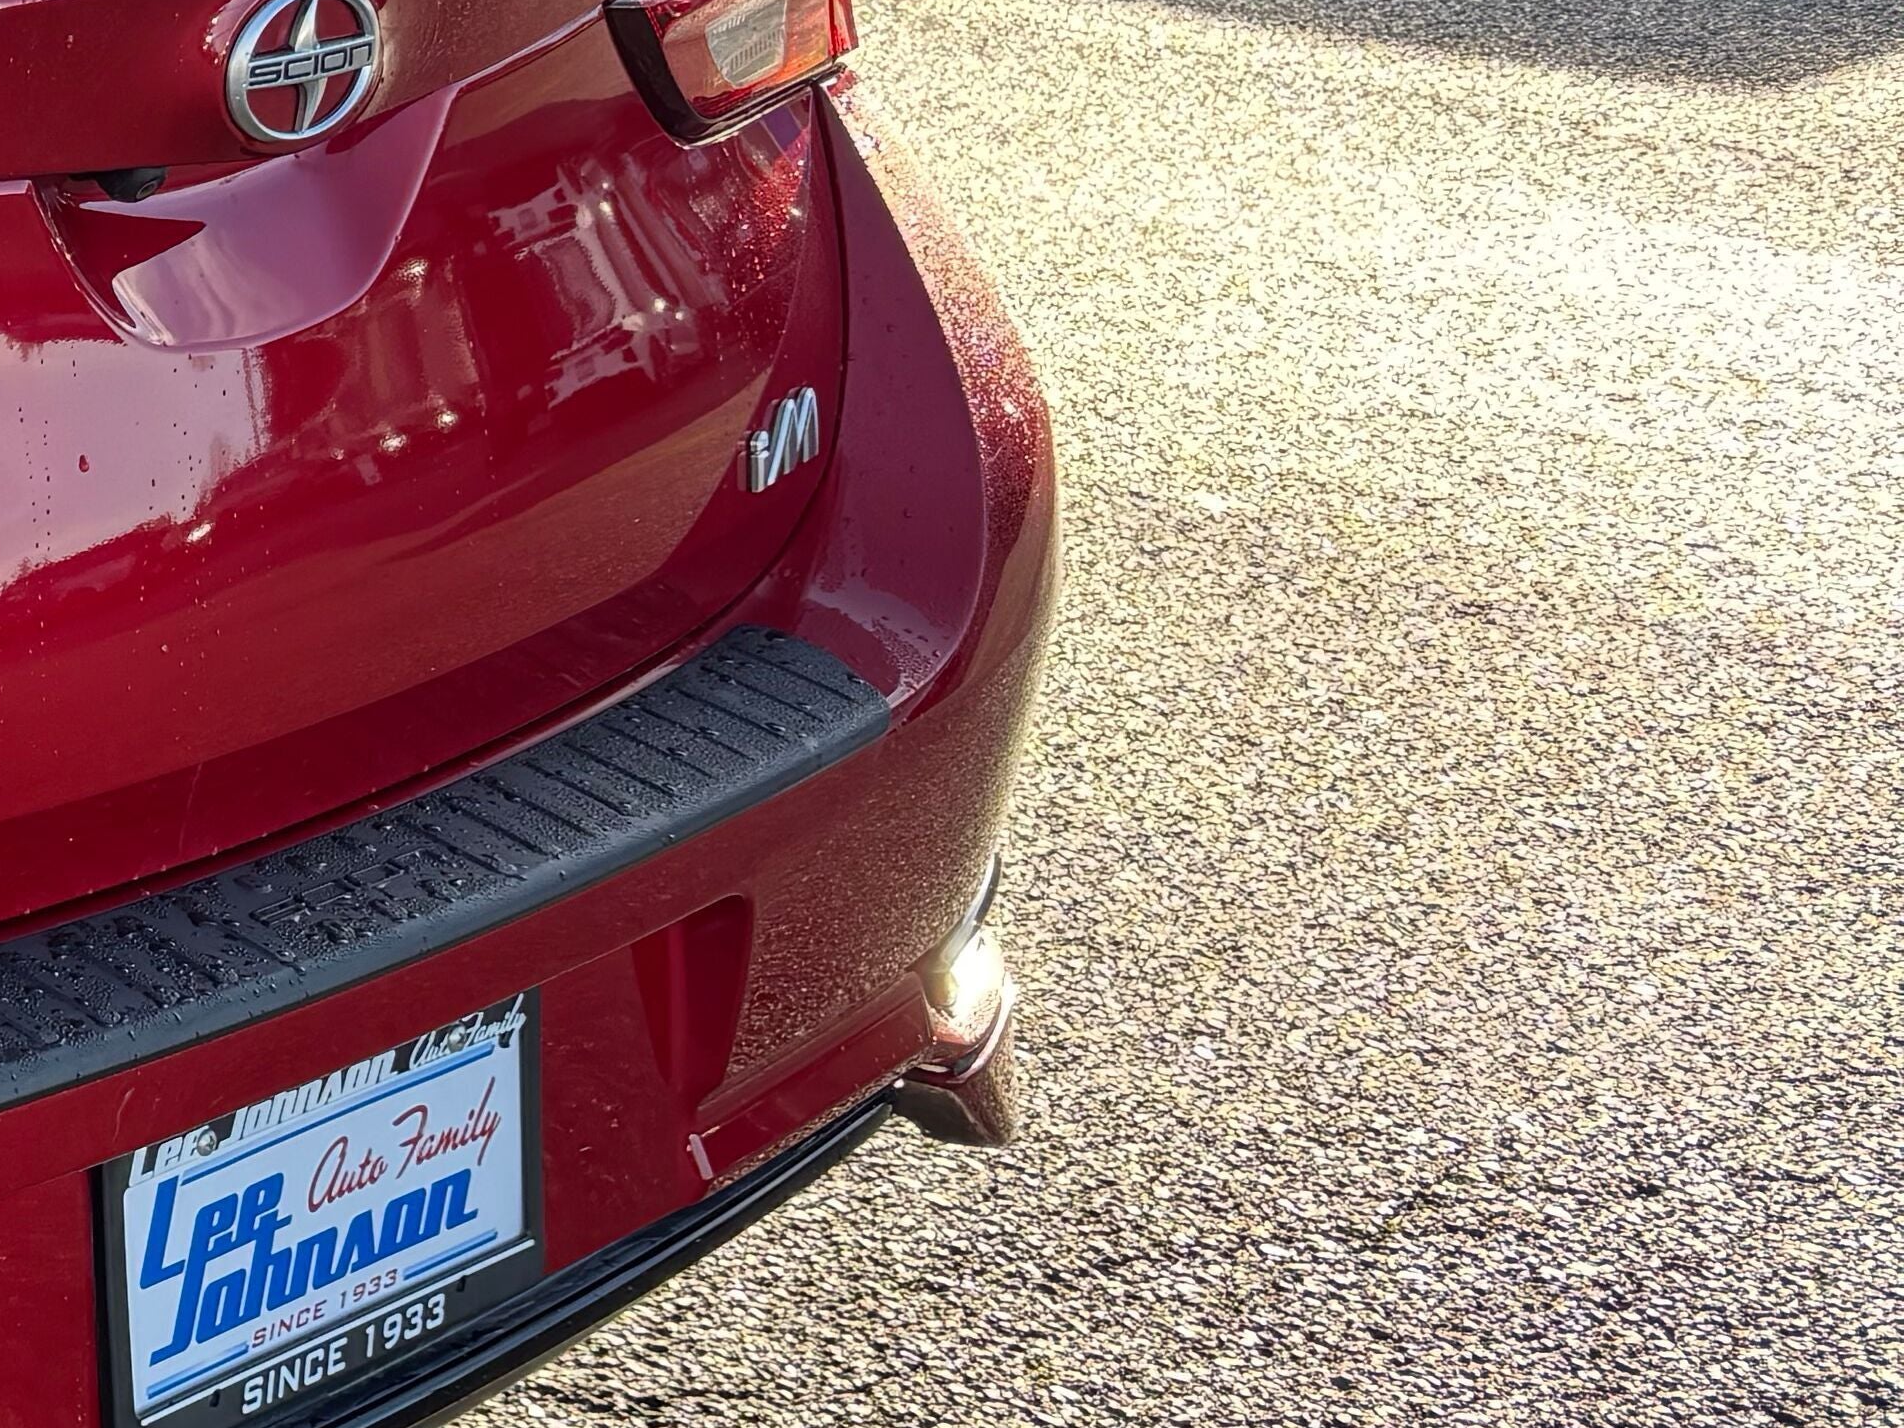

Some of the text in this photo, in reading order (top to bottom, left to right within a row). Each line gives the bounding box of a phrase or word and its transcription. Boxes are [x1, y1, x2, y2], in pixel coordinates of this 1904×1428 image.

[749, 386, 820, 493] iM
[220, 1050, 398, 1147] Johnson
[409, 1029, 453, 1071] Aut
[308, 1076, 501, 1213] Auto Family
[139, 1172, 285, 1290] Lee
[149, 1168, 479, 1368] Johnson
[242, 1293, 446, 1415] SINCE 1933
[252, 1268, 398, 1349] SINCE 1933
